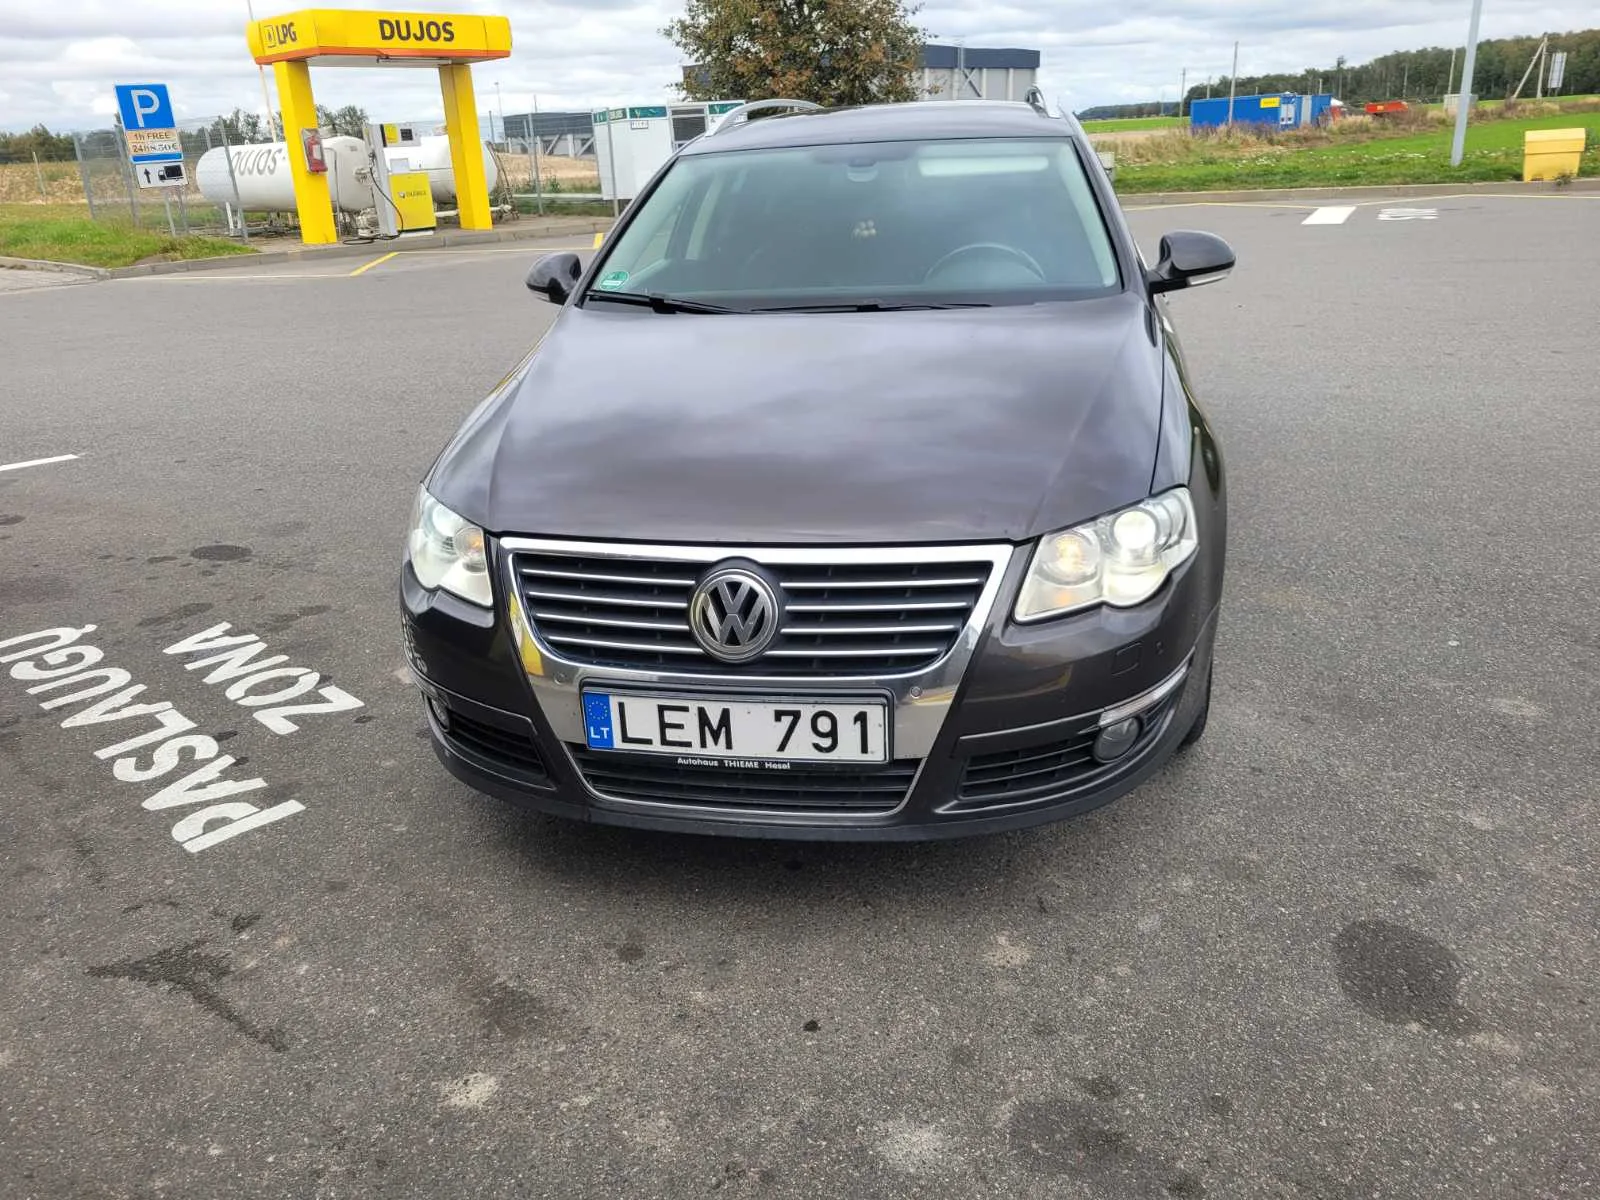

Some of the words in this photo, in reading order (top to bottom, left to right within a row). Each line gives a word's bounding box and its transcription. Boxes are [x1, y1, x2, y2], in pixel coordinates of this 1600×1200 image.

[275, 21, 298, 45] LPG
[378, 19, 455, 42] DUJOS
[130, 89, 160, 128] P
[147, 132, 171, 140] FREE
[162, 621, 366, 735] ZONA
[589, 725, 610, 739] LT
[617, 702, 733, 750] LEM
[774, 708, 869, 754] 791
[677, 757, 719, 767] Autohaus
[723, 760, 760, 769] THIEME
